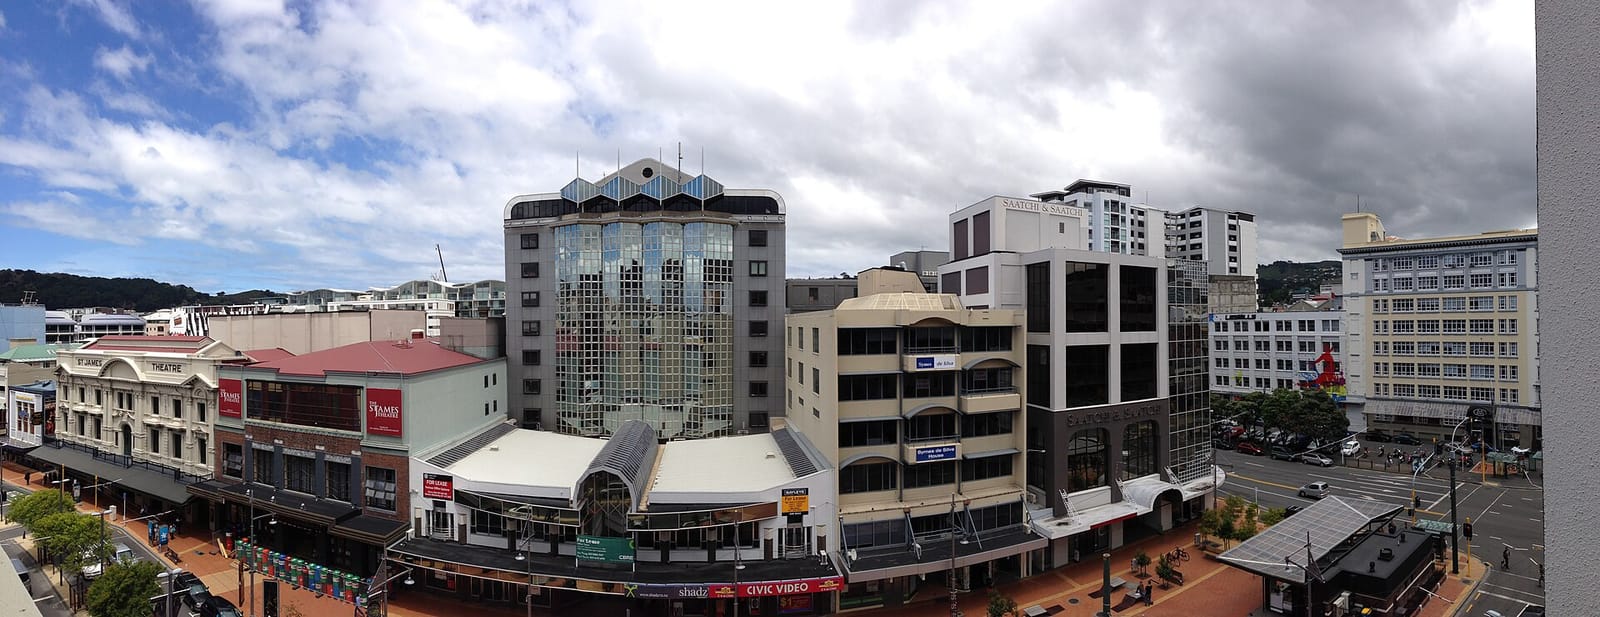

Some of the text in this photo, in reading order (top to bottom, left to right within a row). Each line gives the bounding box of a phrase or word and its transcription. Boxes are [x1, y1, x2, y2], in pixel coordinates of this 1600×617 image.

[1003, 199, 1039, 211] SAATCHI
[1050, 205, 1083, 217] SAATCHI
[84, 359, 102, 367] JAMES
[151, 363, 182, 373] THEATRE
[1067, 410, 1110, 427] SAATCHI
[679, 586, 708, 597] shadz
[747, 585, 773, 595] CIVIC
[776, 582, 808, 593] VIDEO
